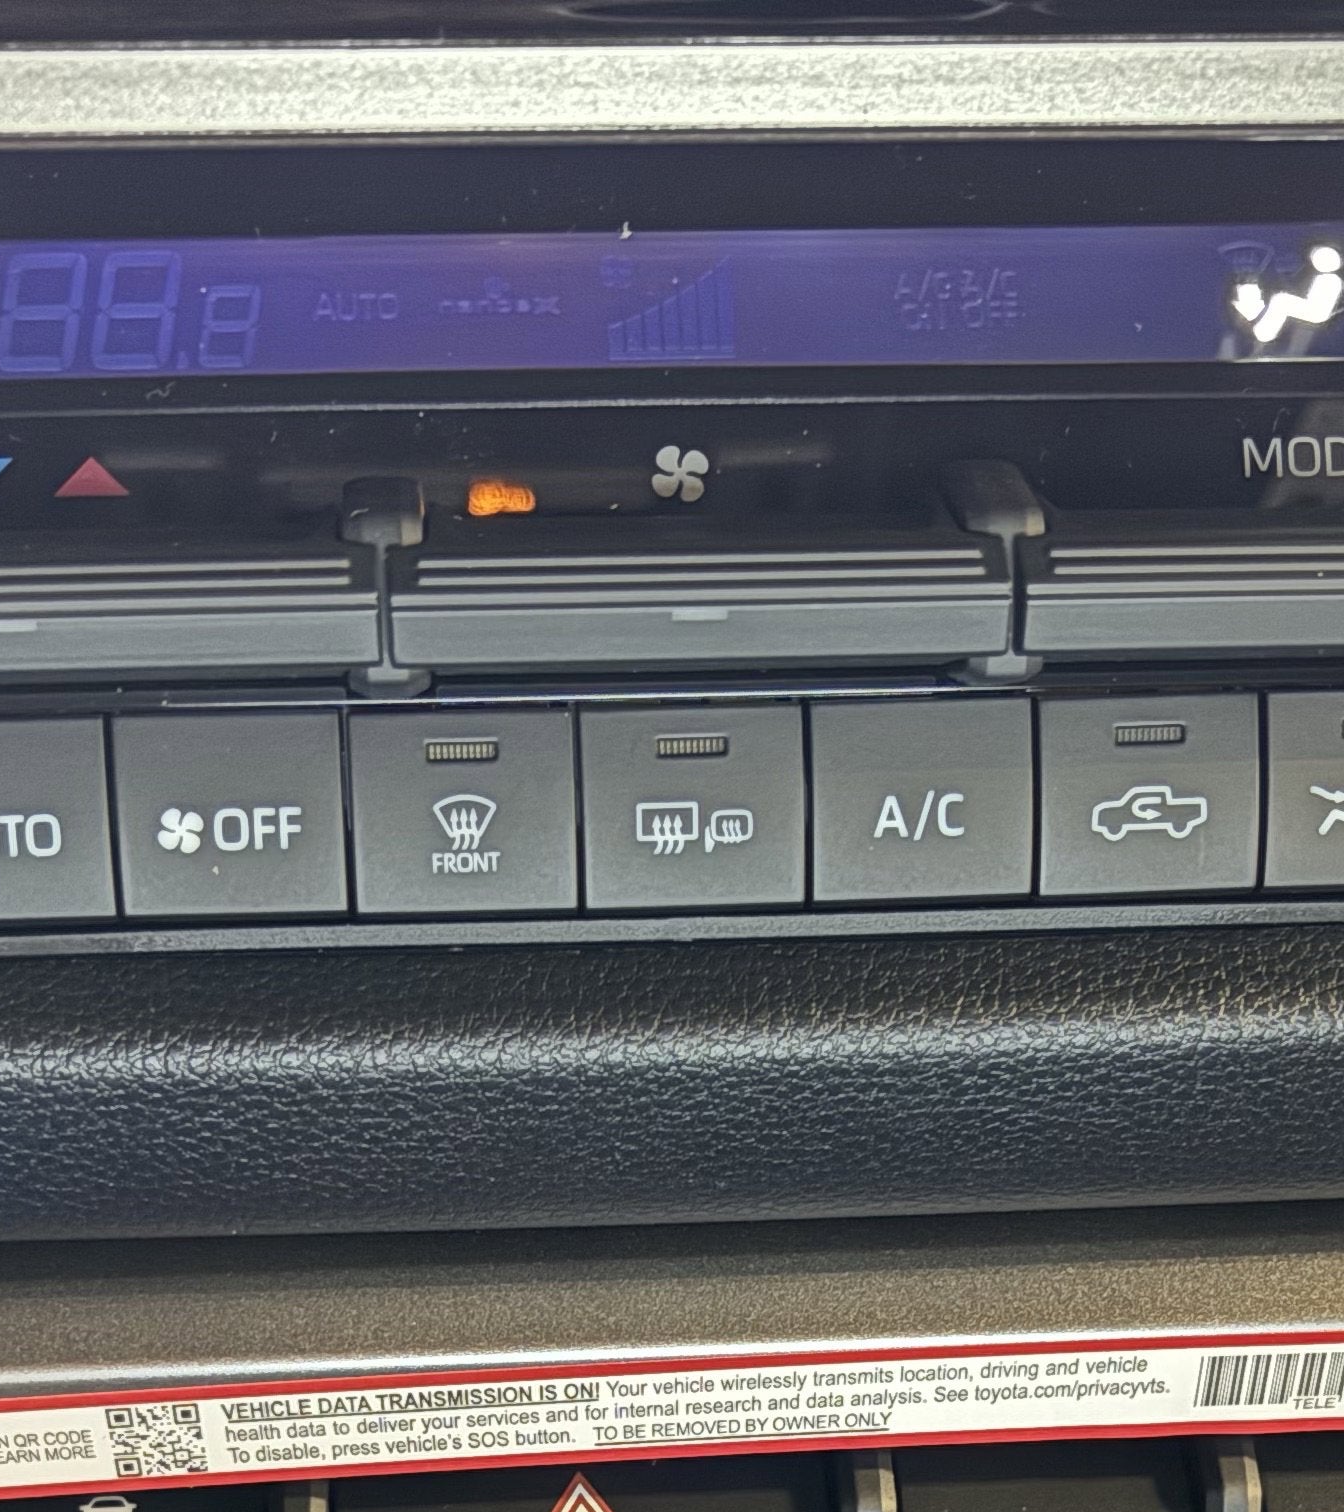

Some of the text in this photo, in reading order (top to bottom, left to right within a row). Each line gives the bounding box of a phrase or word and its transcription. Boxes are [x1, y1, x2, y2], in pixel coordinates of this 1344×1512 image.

[213, 806, 302, 851] OFF
[873, 790, 967, 841] A/C
[432, 851, 501, 874] FRONT
[221, 1355, 1148, 1421] VEHICLE DATA TRANSMISSION IS ON! Your vehicle wirelessly transmits location, driving and vehicle
[1292, 1396, 1337, 1410] TELE
[225, 1378, 1171, 1442] health data to deliver your services and for internal research and data analysis. See toyota.com/privacyvts.
[594, 1411, 893, 1442] TO BE REMOVED BY OWNER ONLY
[13, 1431, 41, 1449] QR
[43, 1429, 93, 1447] CODE
[44, 1444, 97, 1461] MORE
[229, 1428, 577, 1465] To disable, press vehicle's SOS button.
